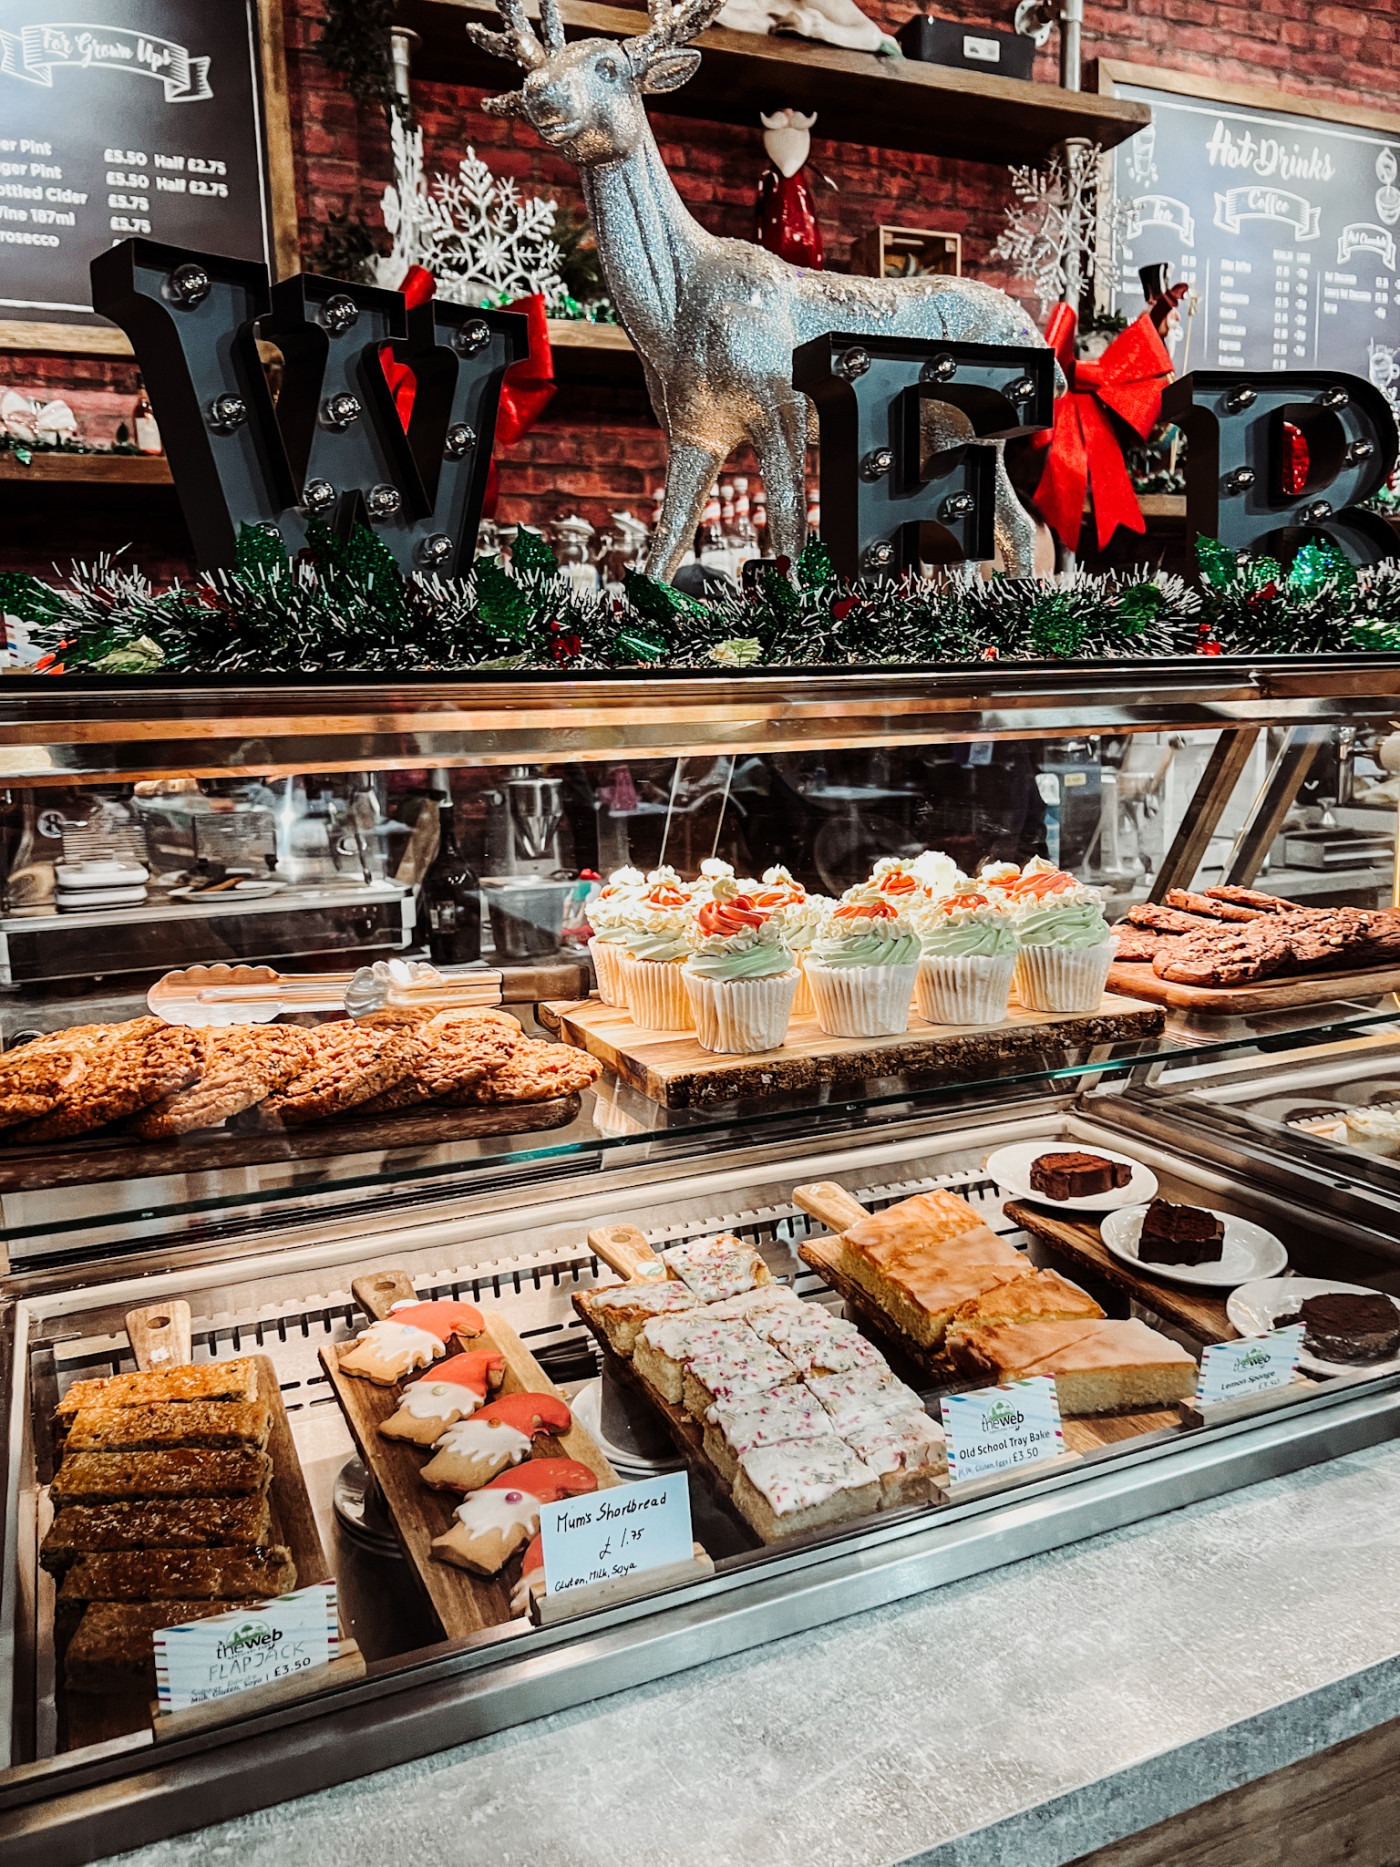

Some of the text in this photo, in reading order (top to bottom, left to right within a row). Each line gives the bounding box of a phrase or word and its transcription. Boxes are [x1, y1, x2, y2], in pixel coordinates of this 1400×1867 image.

[41, 27, 172, 72] For Grown Ups
[0, 139, 52, 156] er Pint
[1205, 119, 1336, 182] Hot Drinks
[0, 162, 62, 180] ger Pint
[103, 148, 227, 176] £5.50 Half £2.75
[105, 171, 228, 198] £5.50 Half £2.75
[45, 187, 88, 205] Cider
[107, 193, 149, 212] £5.75
[1248, 188, 1291, 216] Coffee
[29, 208, 76, 227] 187ml
[110, 215, 151, 234] £5.75
[959, 1448, 976, 1460] Old
[977, 1440, 1008, 1456] School
[1009, 1436, 1029, 1448] Tray
[1029, 1429, 1050, 1443] Bake
[1012, 1446, 1039, 1463] £3.50
[556, 1491, 668, 1533] Mum's Shortbread
[610, 1561, 638, 1577] Soya
[208, 1640, 305, 1683] FLAPJACK
[273, 1656, 312, 1677] £3.50
